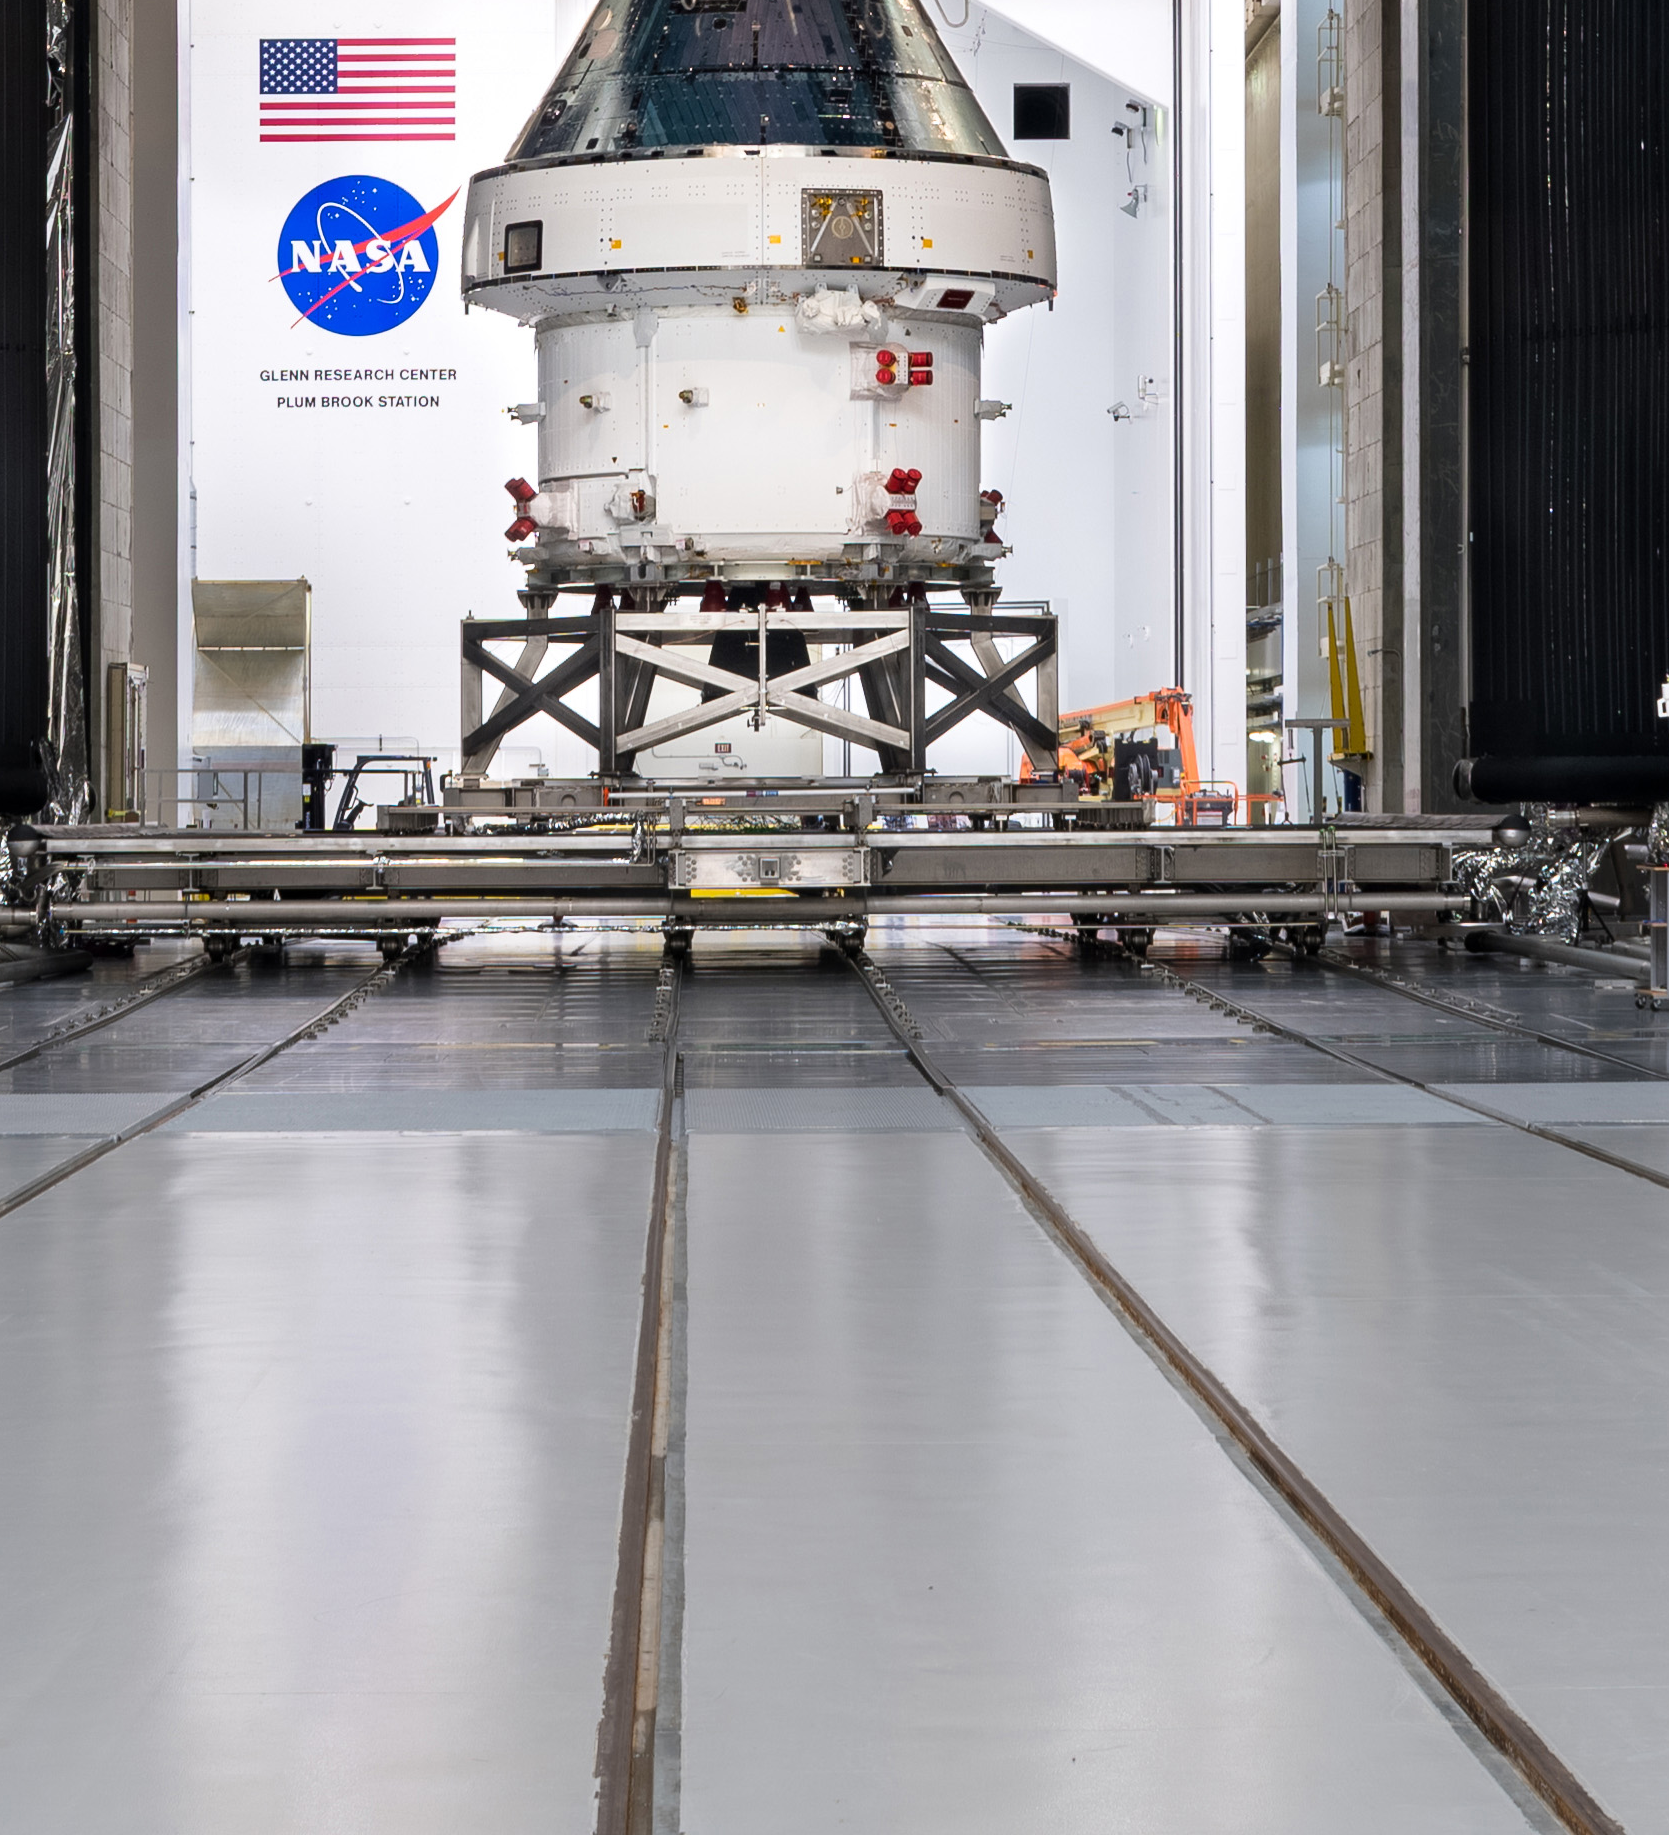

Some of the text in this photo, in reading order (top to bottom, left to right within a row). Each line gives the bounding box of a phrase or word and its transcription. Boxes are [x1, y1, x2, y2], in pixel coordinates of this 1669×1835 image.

[291, 239, 431, 273] NASA
[260, 369, 457, 381] GLENN RESEARCH CENTER
[277, 396, 440, 408] PLUM BROOK STATION
[717, 744, 729, 752] EXIT
